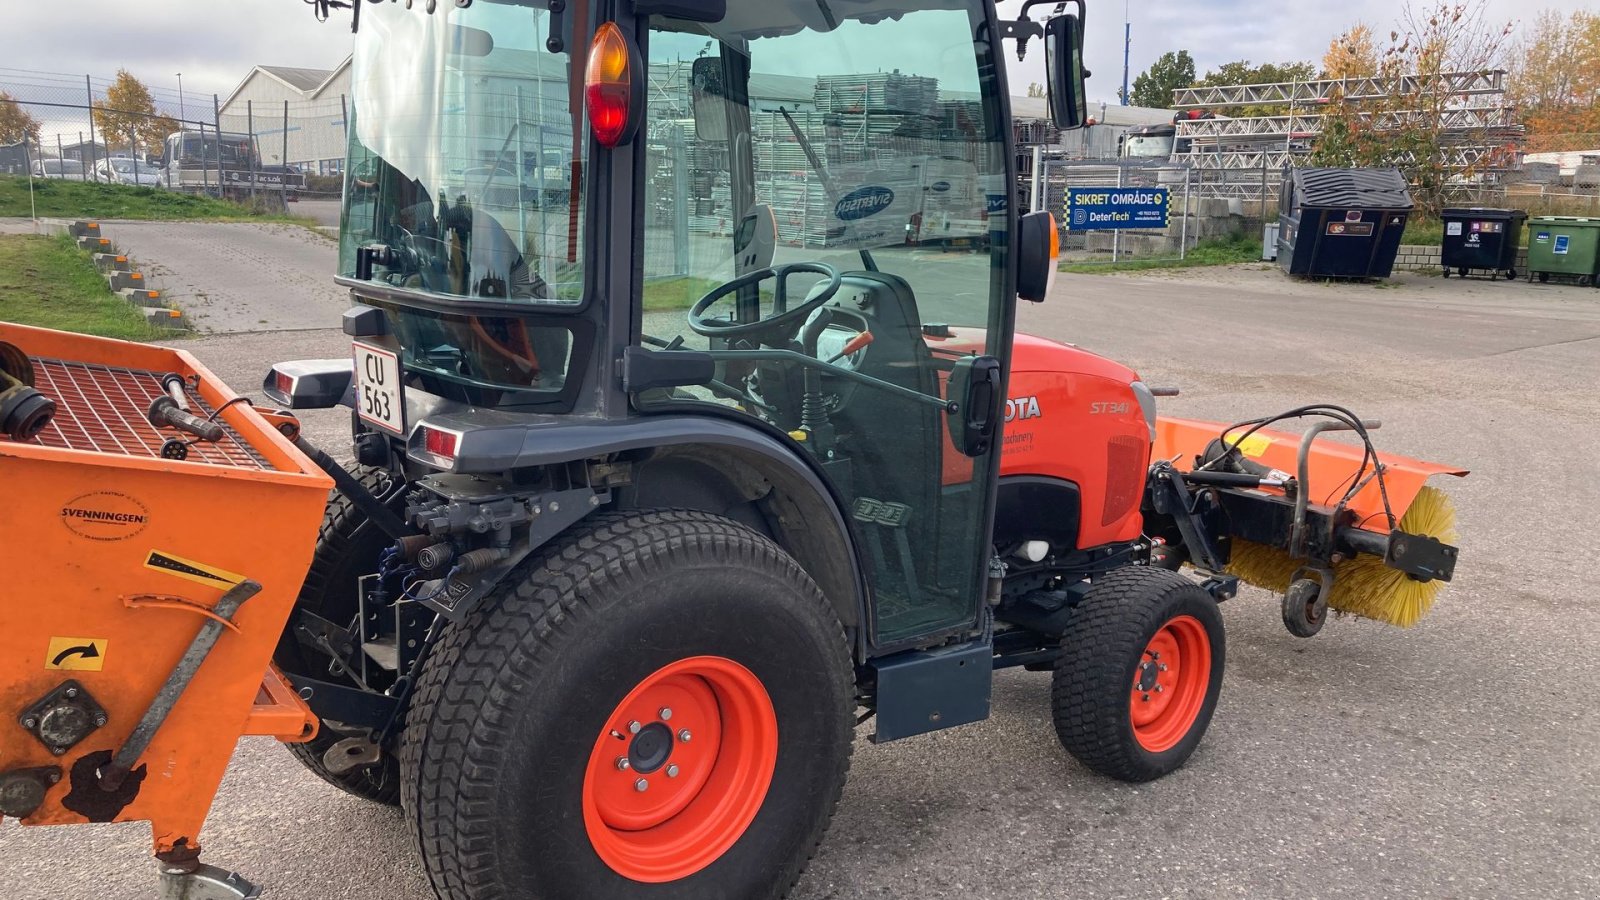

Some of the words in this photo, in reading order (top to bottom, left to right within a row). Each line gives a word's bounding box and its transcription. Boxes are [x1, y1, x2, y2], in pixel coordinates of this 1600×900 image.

[1075, 193, 1110, 205] SIKRET
[1111, 190, 1153, 205] OMRÅDE
[1089, 212, 1129, 222] DeterTech
[366, 353, 384, 386] CU
[365, 385, 391, 422] 563
[1004, 395, 1042, 423] OTA
